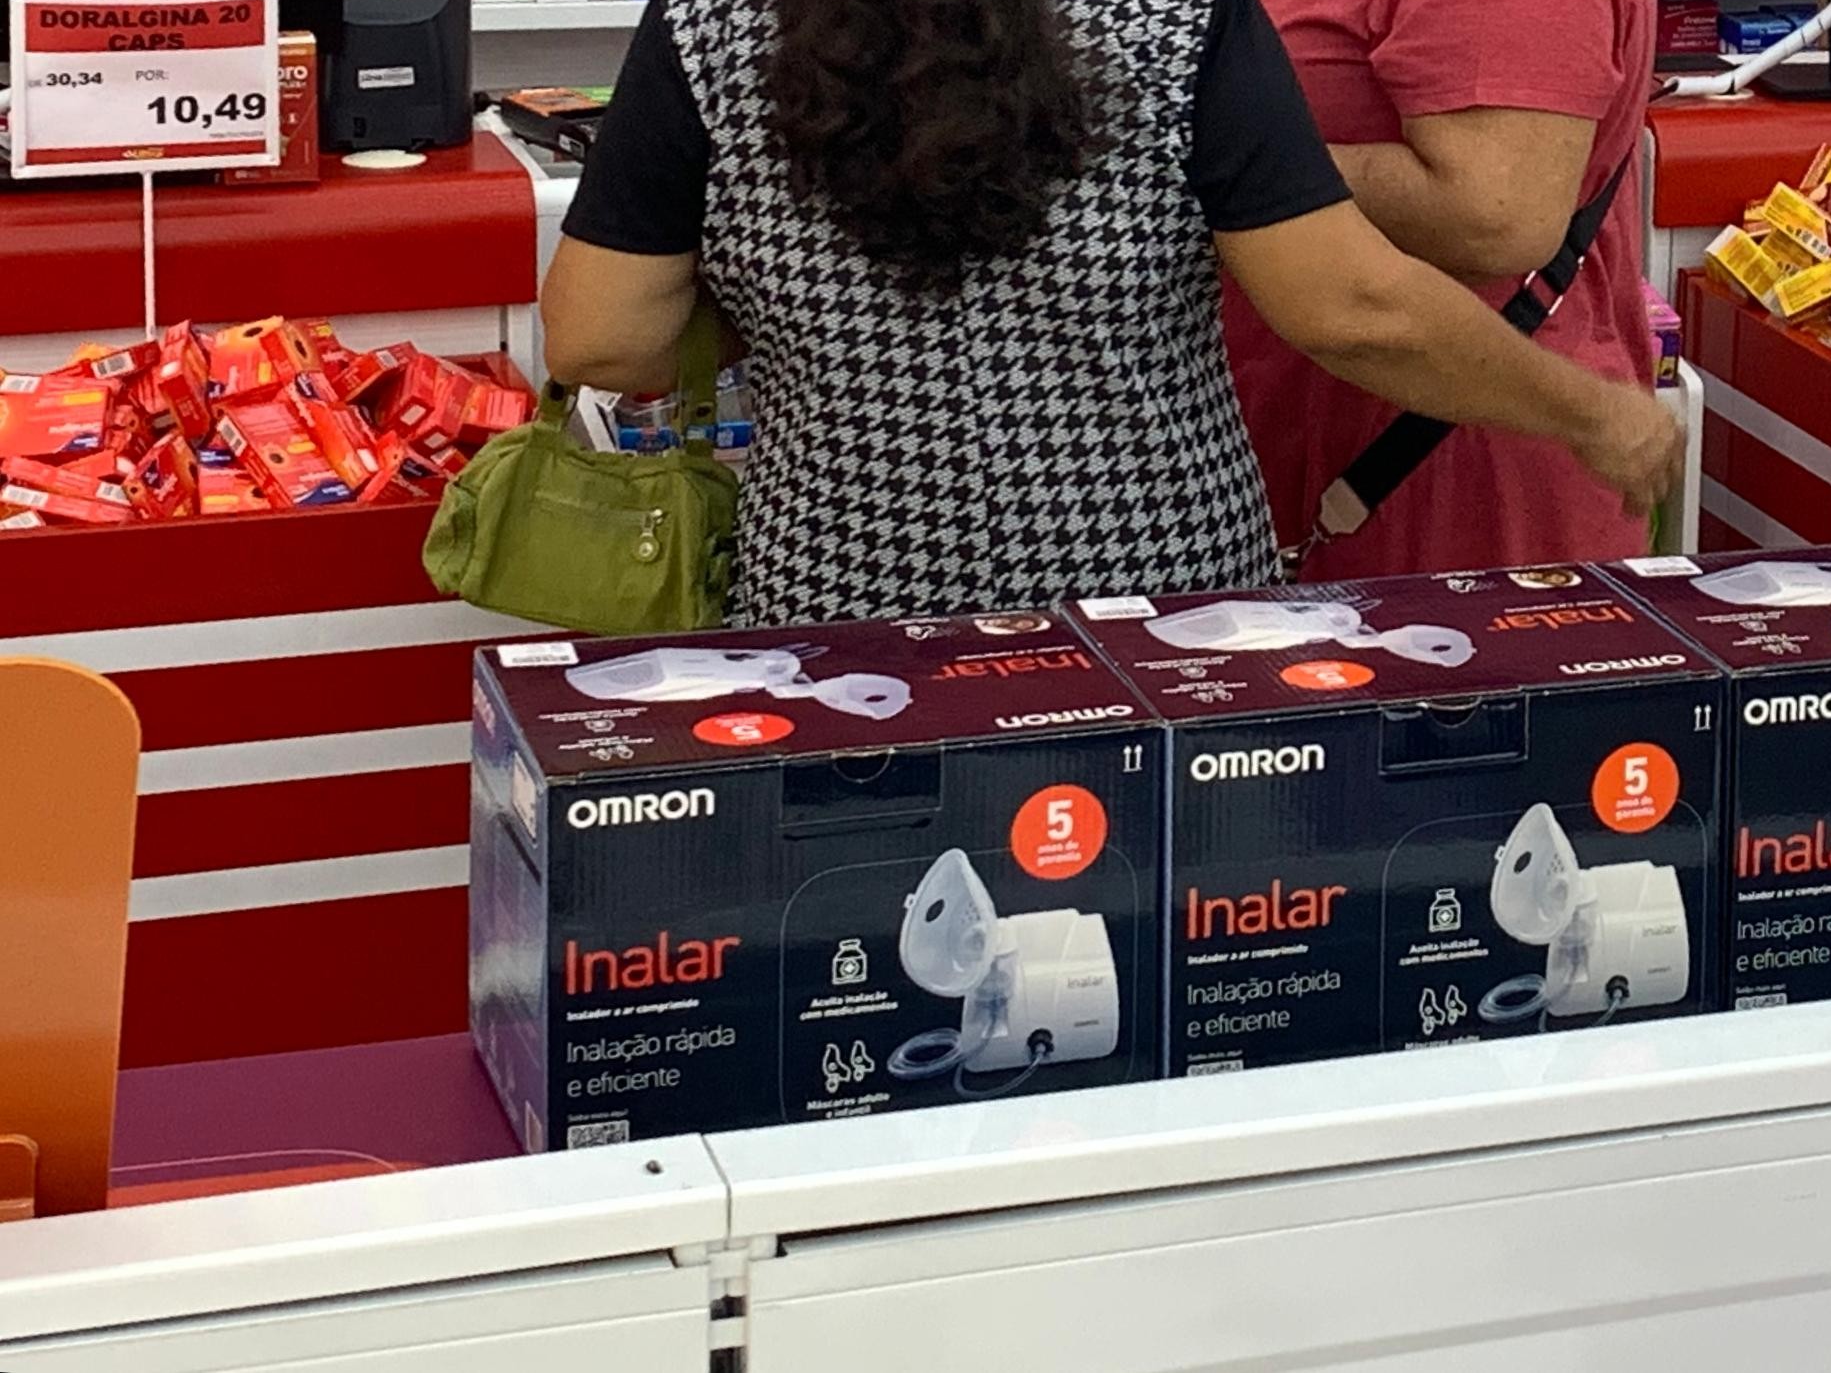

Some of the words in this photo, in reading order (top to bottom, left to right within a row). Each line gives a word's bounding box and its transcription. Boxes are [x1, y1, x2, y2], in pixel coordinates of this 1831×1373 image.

[40, 7, 210, 29] DORALGINA
[218, 4, 250, 24] 20
[108, 32, 185, 51] CAPS
[46, 71, 103, 88] 30,34
[148, 92, 267, 128] 10,49
[1487, 606, 1635, 632] Inalar
[931, 652, 1093, 680] Inalar
[1559, 654, 1687, 674] OMRON
[995, 704, 1134, 727] OMRON
[1191, 744, 1326, 782] OMRON
[1624, 756, 1649, 796] 5
[567, 788, 715, 829] OMRON
[1046, 799, 1074, 841] 5
[1187, 879, 1348, 940] Inalar
[1736, 912, 1815, 941] Inalação
[566, 929, 742, 995] Inalar
[1736, 955, 1749, 972] e
[1752, 944, 1831, 971] eficiente
[1187, 977, 1273, 1006] Inalação
[1278, 969, 1342, 999] rápida
[1187, 1021, 1201, 1038] e
[1205, 1009, 1291, 1036] eficiente
[566, 1033, 660, 1063] Inalação
[665, 1024, 737, 1056] rápida
[566, 1079, 582, 1097] e
[586, 1067, 681, 1095] eficiente
